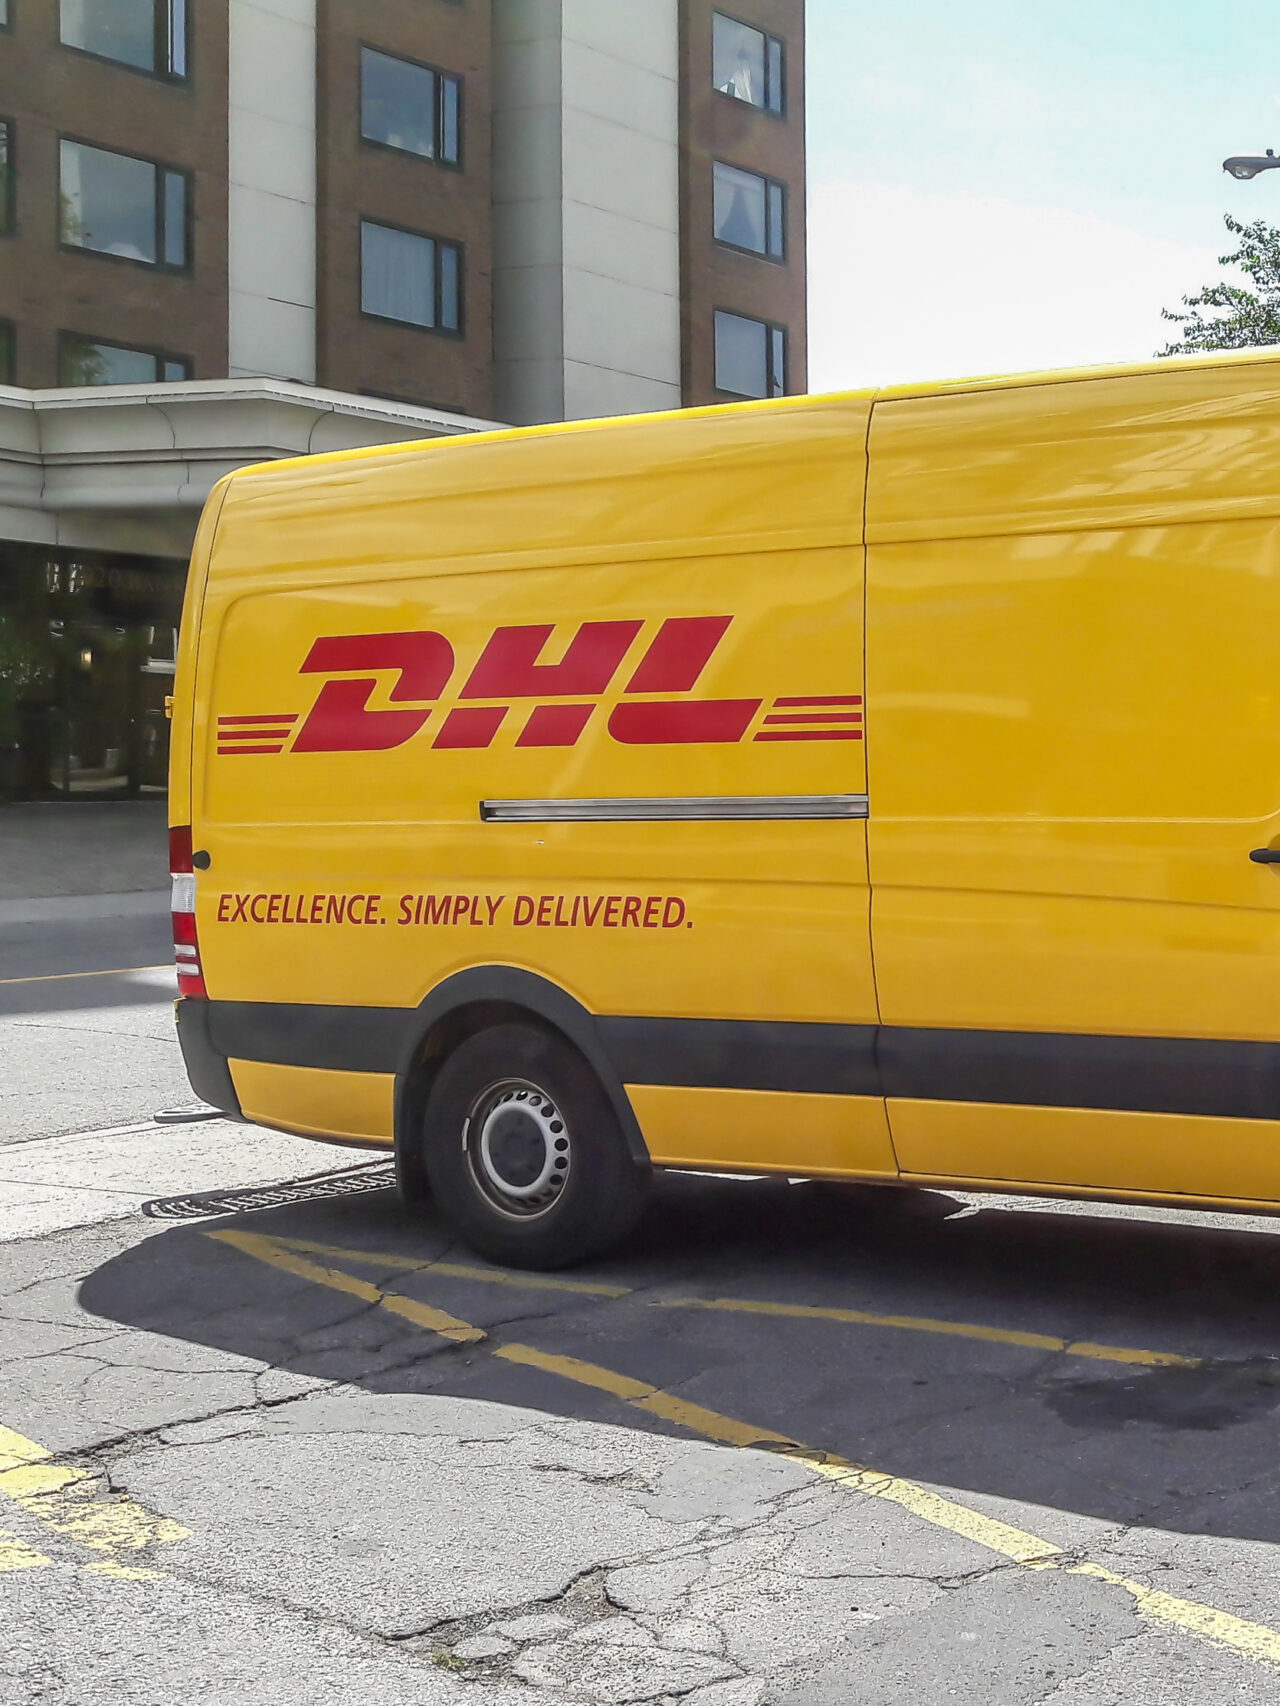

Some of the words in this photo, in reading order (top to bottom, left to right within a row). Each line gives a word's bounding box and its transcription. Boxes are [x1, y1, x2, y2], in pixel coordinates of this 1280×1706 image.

[289, 615, 764, 753] DHL
[217, 894, 386, 925] EXCELLENCE.
[397, 894, 505, 926] SIMPLY
[513, 895, 694, 929] DELIVERED.
